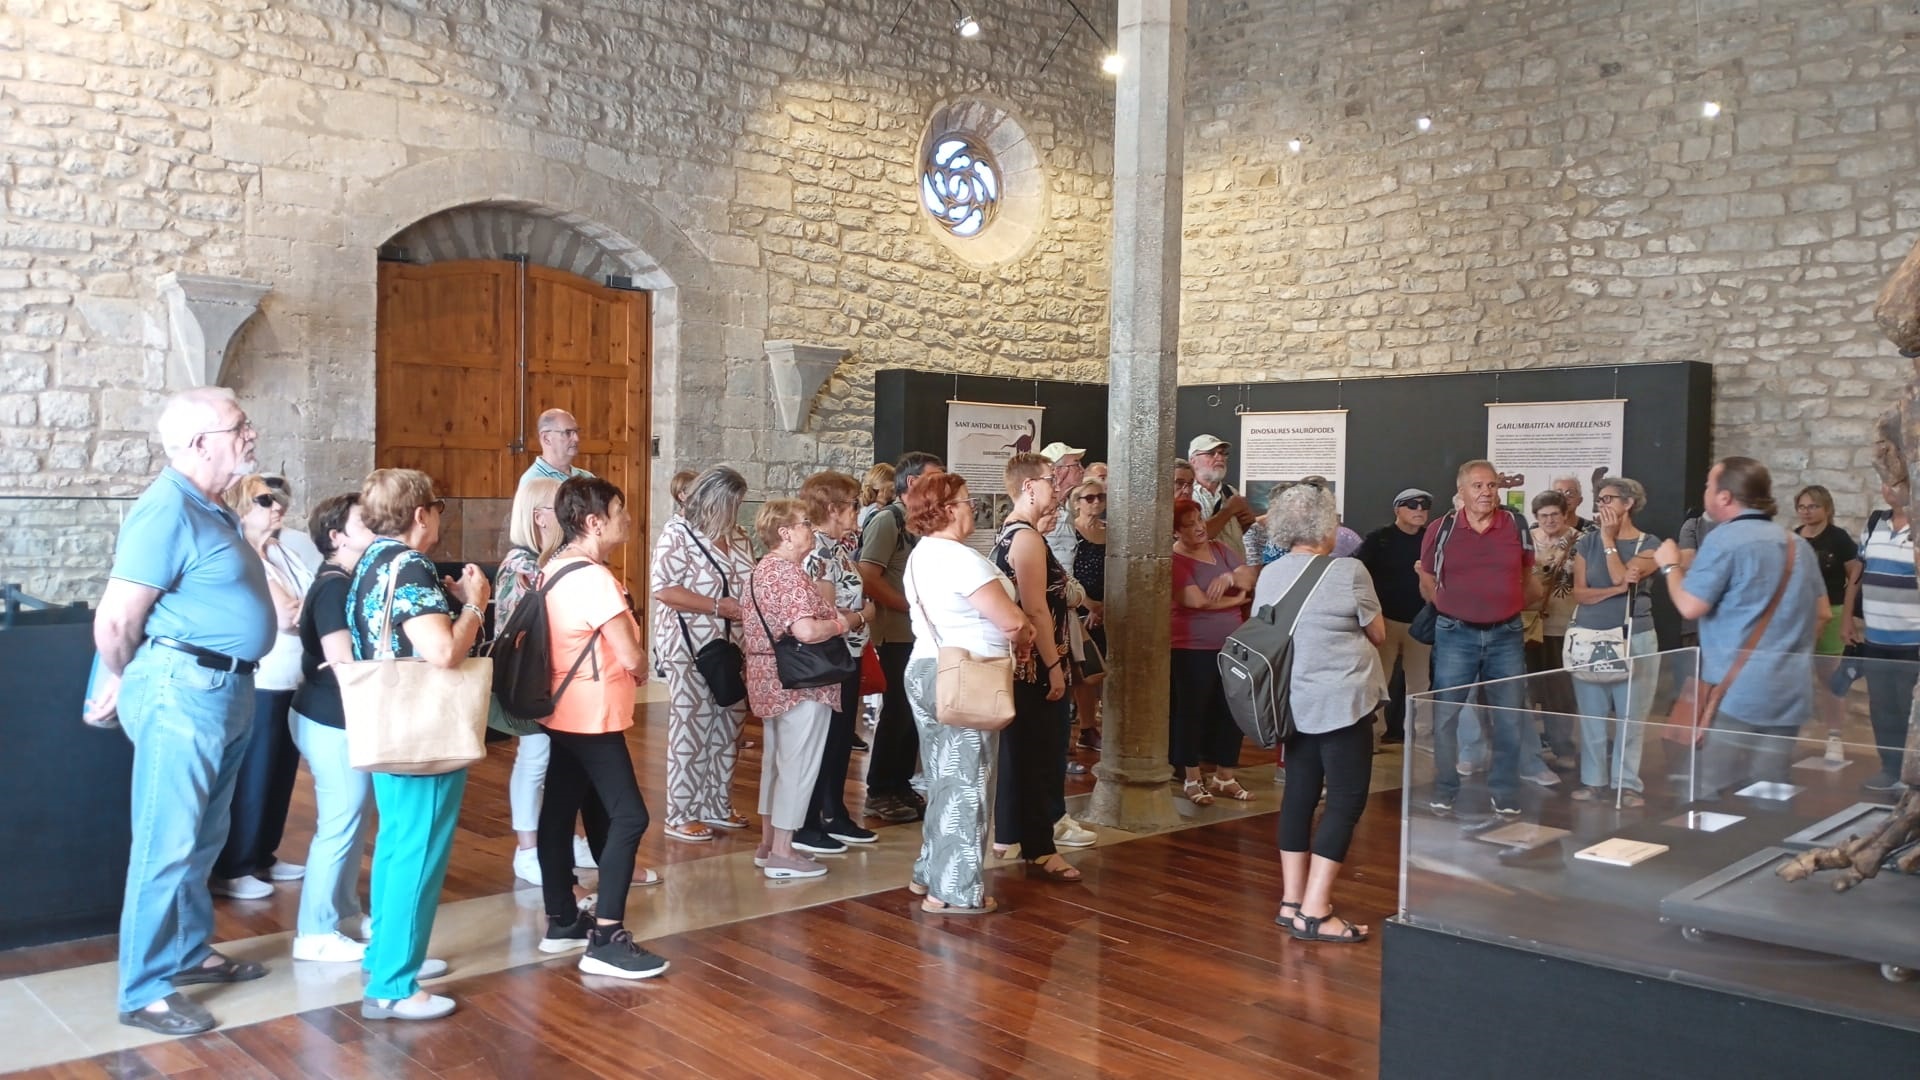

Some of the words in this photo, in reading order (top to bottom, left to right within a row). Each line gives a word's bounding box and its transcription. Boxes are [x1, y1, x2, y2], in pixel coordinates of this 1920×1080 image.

[1496, 422, 1554, 430] GARUMBATITAN
[1557, 420, 1611, 429] MORELLENSIS
[1250, 427, 1290, 435] DINOSAURES
